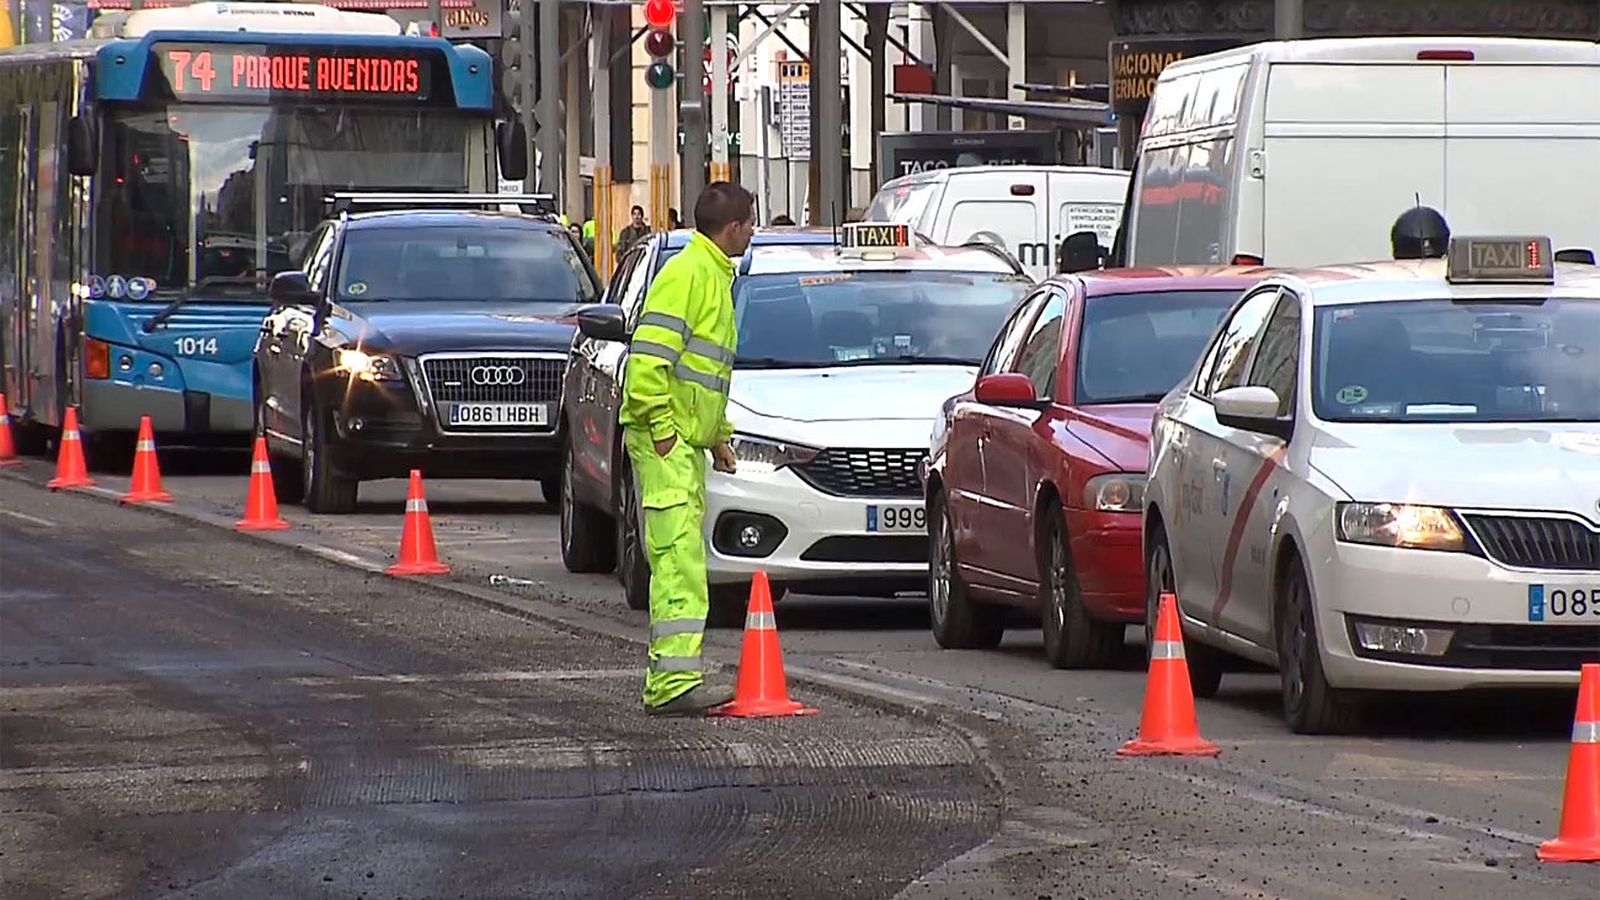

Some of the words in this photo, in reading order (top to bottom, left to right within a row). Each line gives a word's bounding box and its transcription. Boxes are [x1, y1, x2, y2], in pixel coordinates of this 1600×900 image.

[169, 52, 216, 91] 74
[231, 55, 311, 90] PARQUE
[317, 57, 419, 92] AVENIDAS
[858, 227, 895, 245] TAXI
[1473, 244, 1520, 267] TAXI
[1527, 242, 1540, 269] 1
[174, 337, 218, 355] 1014
[460, 406, 502, 422] 0861
[507, 406, 539, 422] HBH
[884, 507, 926, 528] 999
[1551, 589, 1600, 616] 085
